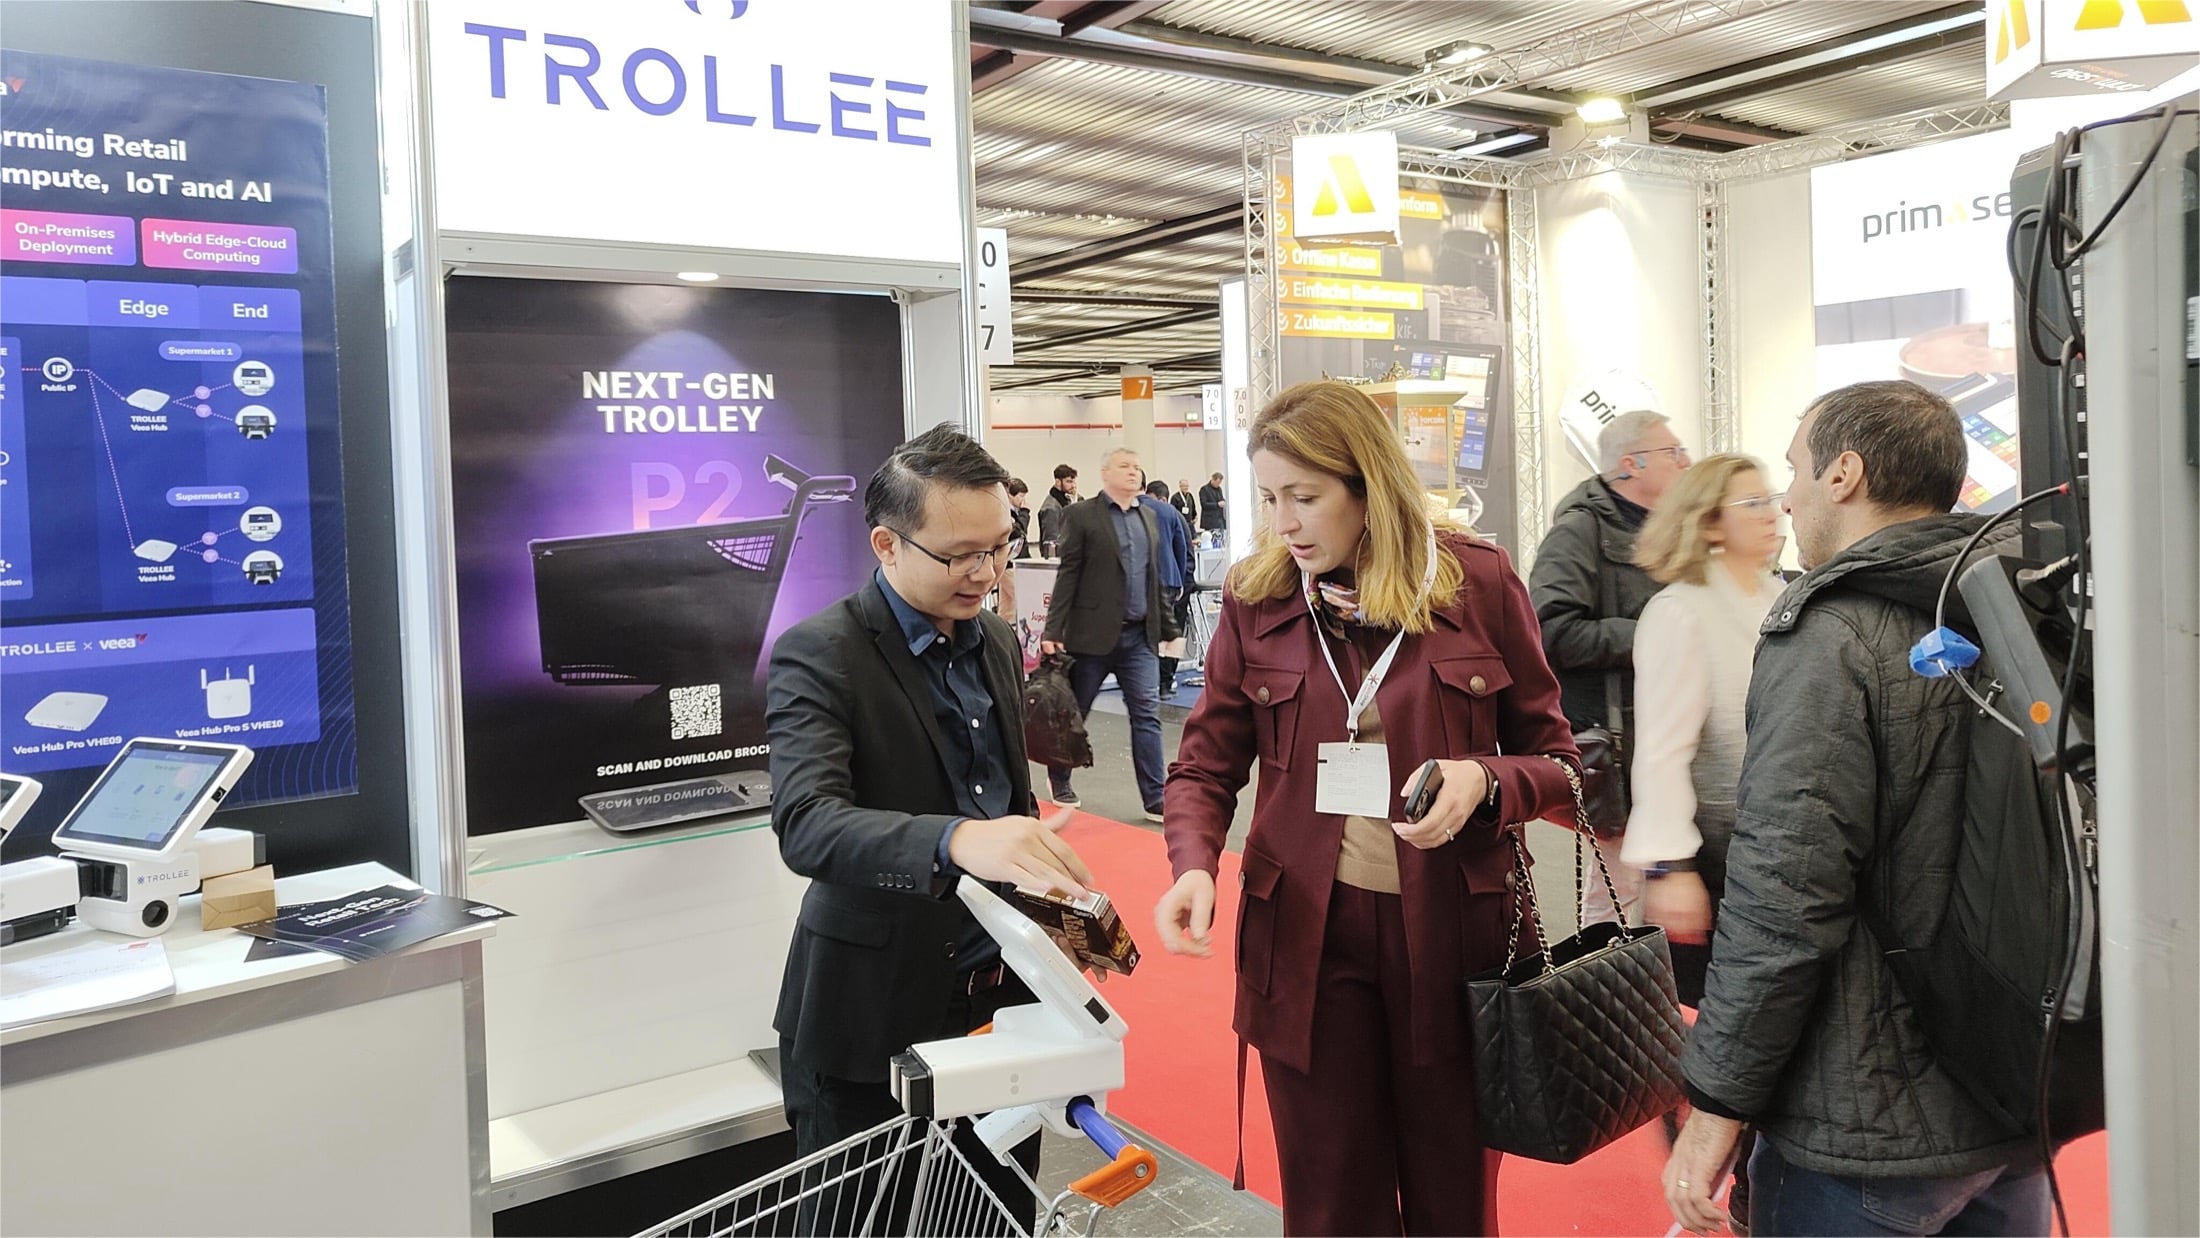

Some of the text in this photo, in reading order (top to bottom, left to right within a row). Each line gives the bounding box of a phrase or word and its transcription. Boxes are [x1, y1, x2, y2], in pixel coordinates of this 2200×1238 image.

[464, 21, 932, 147] TROLLEE
[1, 128, 188, 162] rming Retail
[0, 167, 272, 203] mpute, IoT and AI
[15, 221, 115, 240] On-Premises
[19, 238, 113, 256] Deployment
[153, 230, 287, 250] Hybrid Edge-Cloud
[183, 248, 260, 266] Computing
[119, 299, 268, 319] Edge End
[168, 346, 234, 357] Supermarket 1
[51, 364, 67, 375] IP
[582, 371, 775, 400] NEXT-GEN
[1138, 379, 1148, 397] 7
[130, 415, 167, 423] TROLLEE
[596, 405, 764, 434] TROLLEY
[175, 491, 240, 501] Supermarket 2
[630, 460, 746, 531] P2
[138, 565, 174, 574] TROLLEE
[0, 641, 76, 657] TROLLEE
[99, 637, 136, 651] veea
[201, 726, 222, 736] Hub
[223, 724, 241, 734] Pro
[251, 720, 284, 731] VHE10
[41, 742, 64, 752] Hub
[66, 740, 85, 750] Pro
[596, 763, 633, 777] SCAN
[635, 759, 662, 772] AND
[664, 750, 733, 768] DOWNLOAD
[147, 870, 190, 883] TROLLEE
